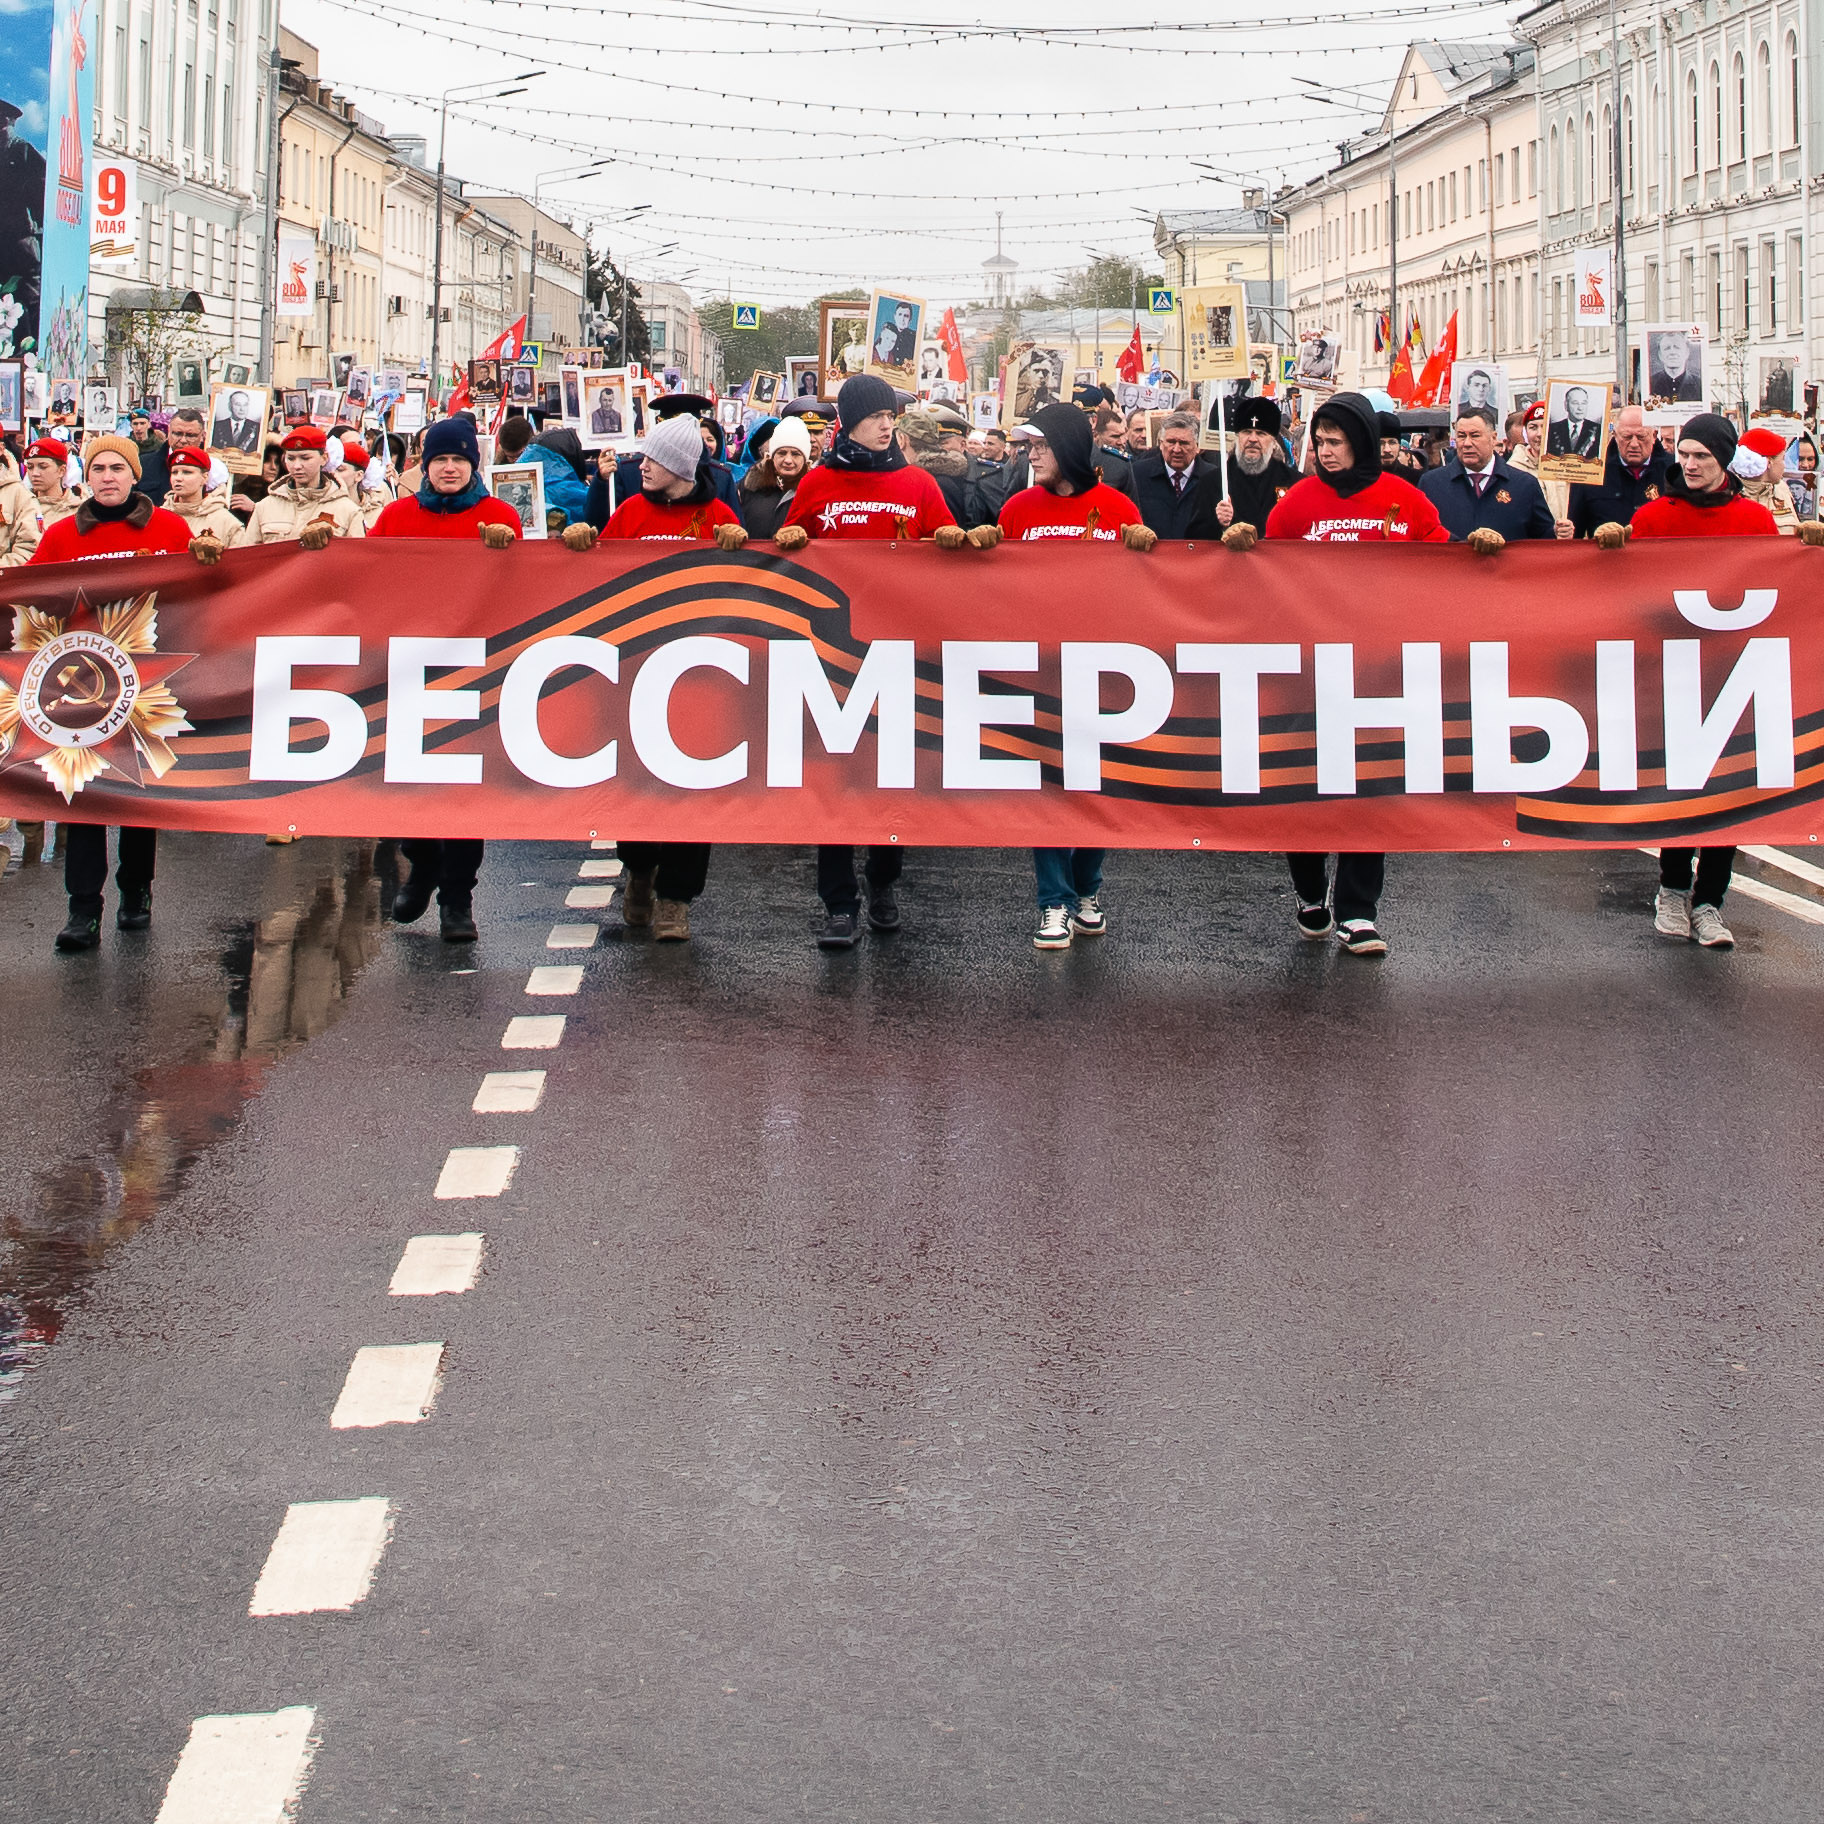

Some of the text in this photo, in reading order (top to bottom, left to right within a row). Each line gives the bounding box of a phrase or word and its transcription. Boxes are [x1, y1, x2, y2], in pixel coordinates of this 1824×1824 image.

[98, 167, 126, 217] 9
[95, 220, 126, 234] МАЯ
[832, 501, 916, 518] БЕССМЕРТНЫЙ
[842, 514, 868, 524] ПОЛК
[1318, 518, 1408, 535] БЕССМЕРТЫЙ
[1330, 532, 1359, 541] ПОЛК
[24, 635, 128, 736] ОТЕЧЕСТВЕННАЯ
[249, 589, 1795, 794] БЕССМЕРТНЫЙ
